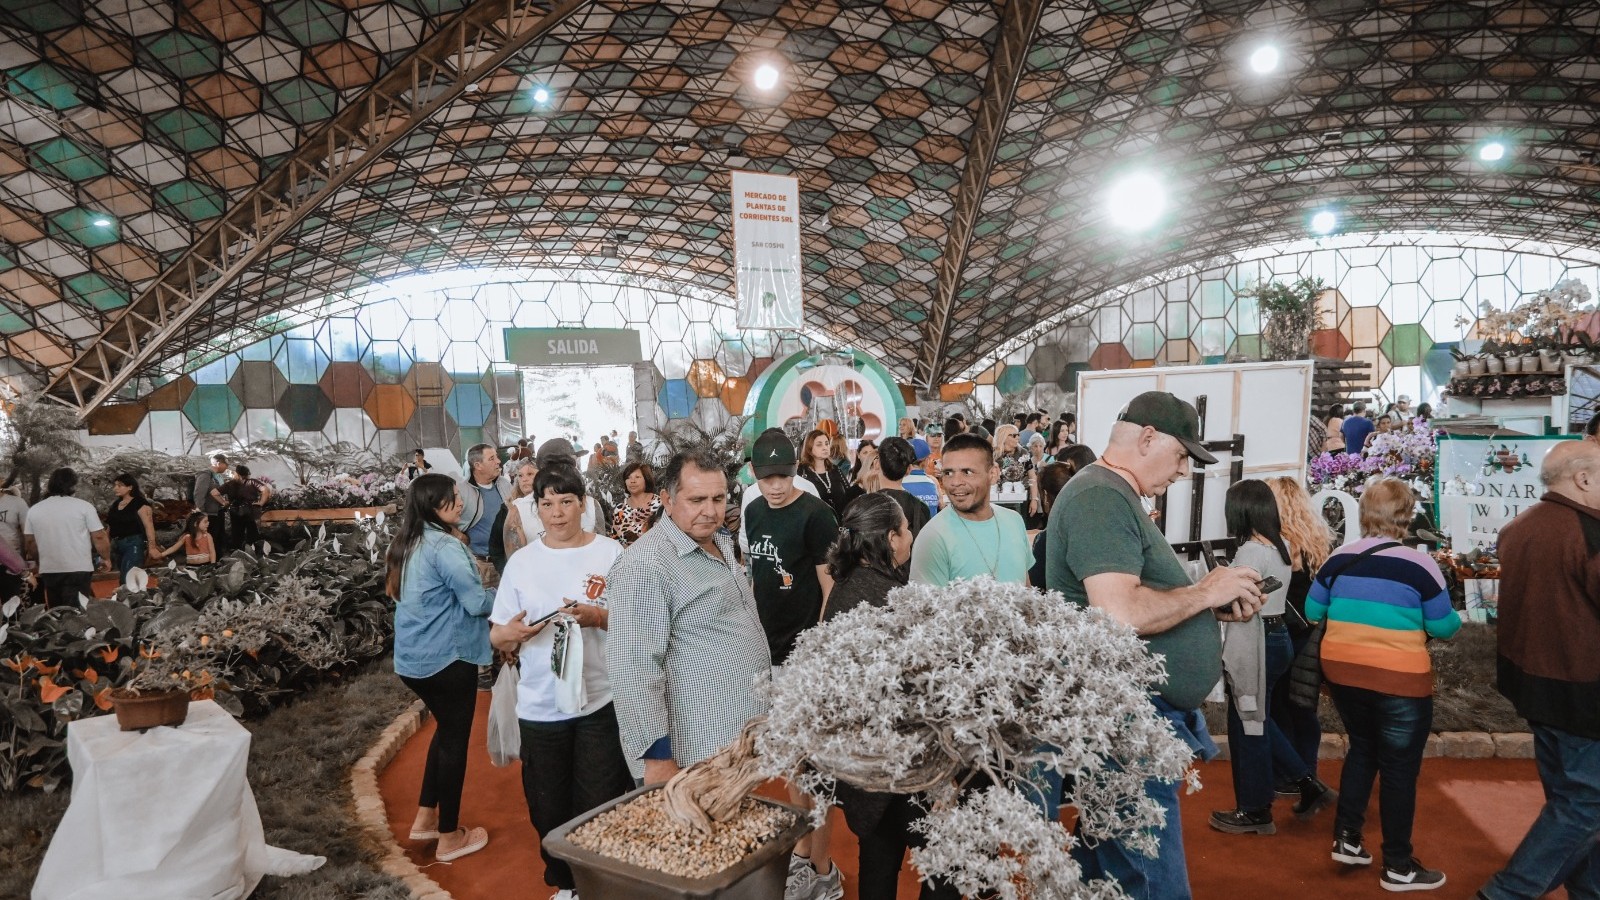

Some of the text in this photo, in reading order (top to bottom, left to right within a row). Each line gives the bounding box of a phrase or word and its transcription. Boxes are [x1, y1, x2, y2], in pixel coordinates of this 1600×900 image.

[744, 192, 777, 201] MERCADO
[746, 202, 776, 211] PLANTAS
[739, 212, 794, 223] CORRIENTES SRL
[547, 339, 599, 355] SALIDA
